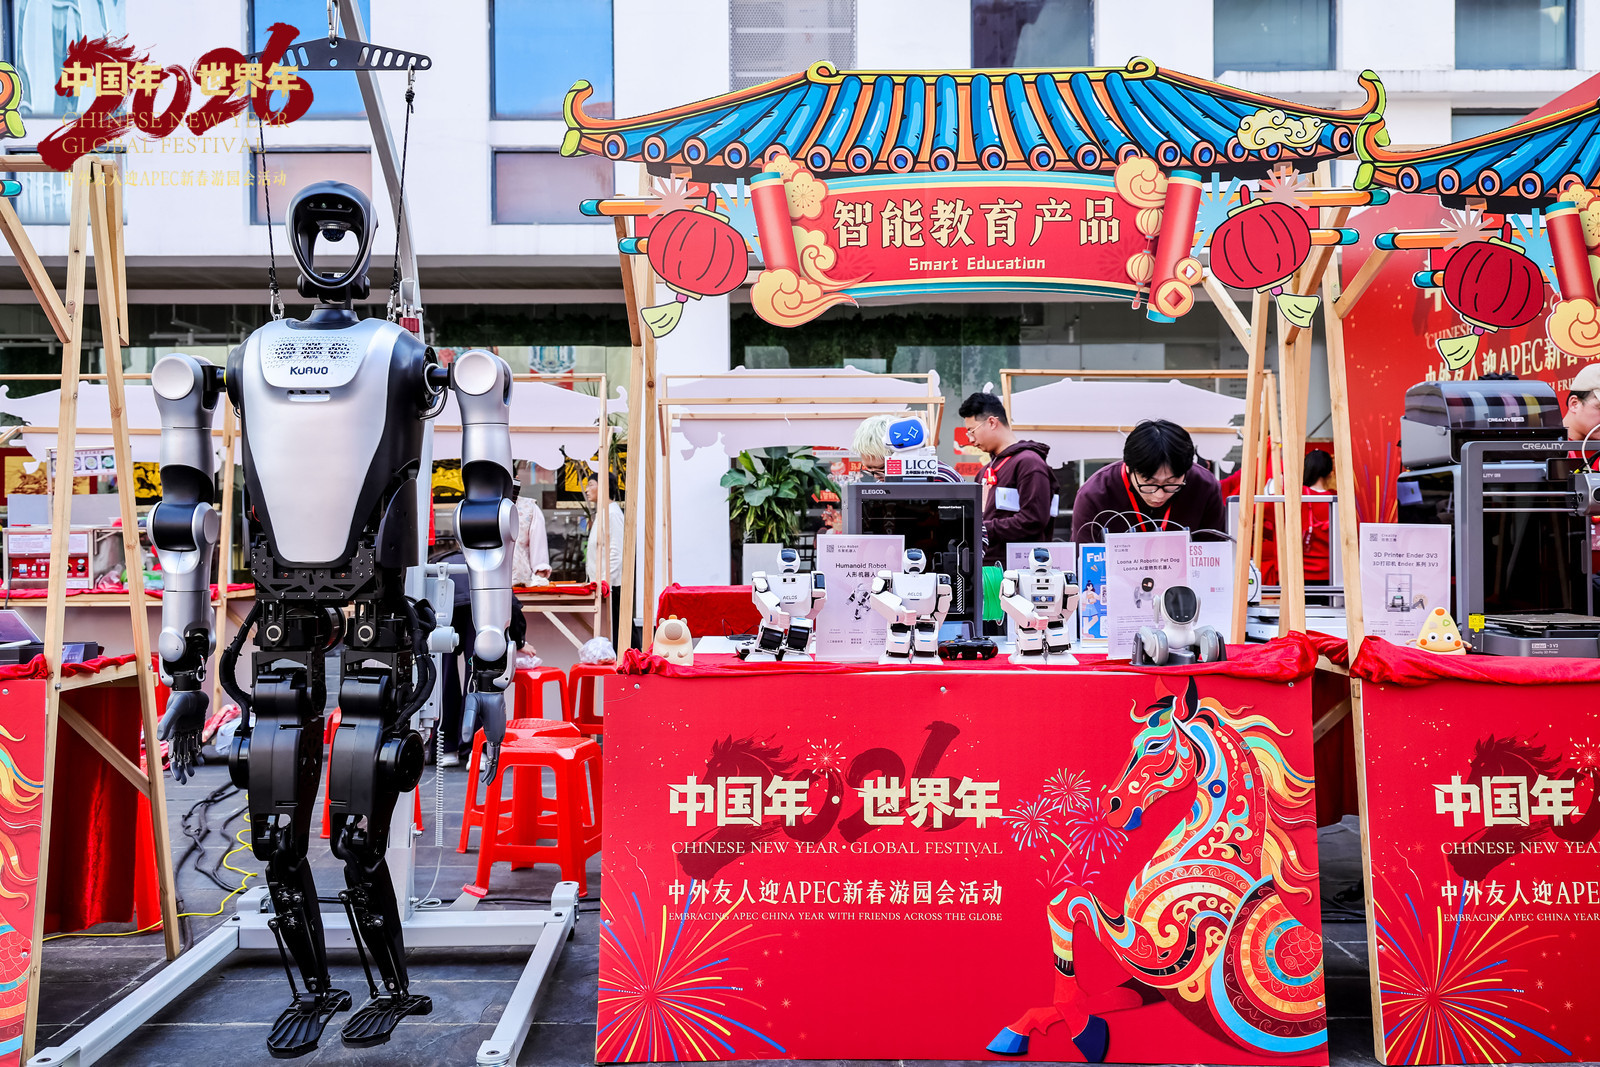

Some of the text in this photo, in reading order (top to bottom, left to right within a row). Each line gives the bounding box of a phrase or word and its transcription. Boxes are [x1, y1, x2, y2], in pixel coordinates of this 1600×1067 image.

[833, 197, 1121, 249] 智能教育产品
[908, 256, 1047, 272] Smart Education
[289, 366, 329, 376] KUAVO
[1522, 442, 1564, 450] CREALITY
[905, 459, 937, 470] LICC
[1190, 556, 1221, 567] LTATION
[671, 841, 745, 854] CHINESE
[750, 841, 790, 854] NEW
[924, 841, 1004, 854] FESTIVAL
[1440, 841, 1600, 855] CHINESE NEW YEA
[668, 879, 1003, 906] 中外友人迎APEC新春游园会活动
[1441, 879, 1600, 906] 中外友人迎APE
[668, 911, 1003, 921] EMBRACING APEC CHINA YEAR WITH FRIENDS ACROSS THE GLOBE
[1443, 912, 1600, 922] EMBRACING APEC CHINA YEAR
